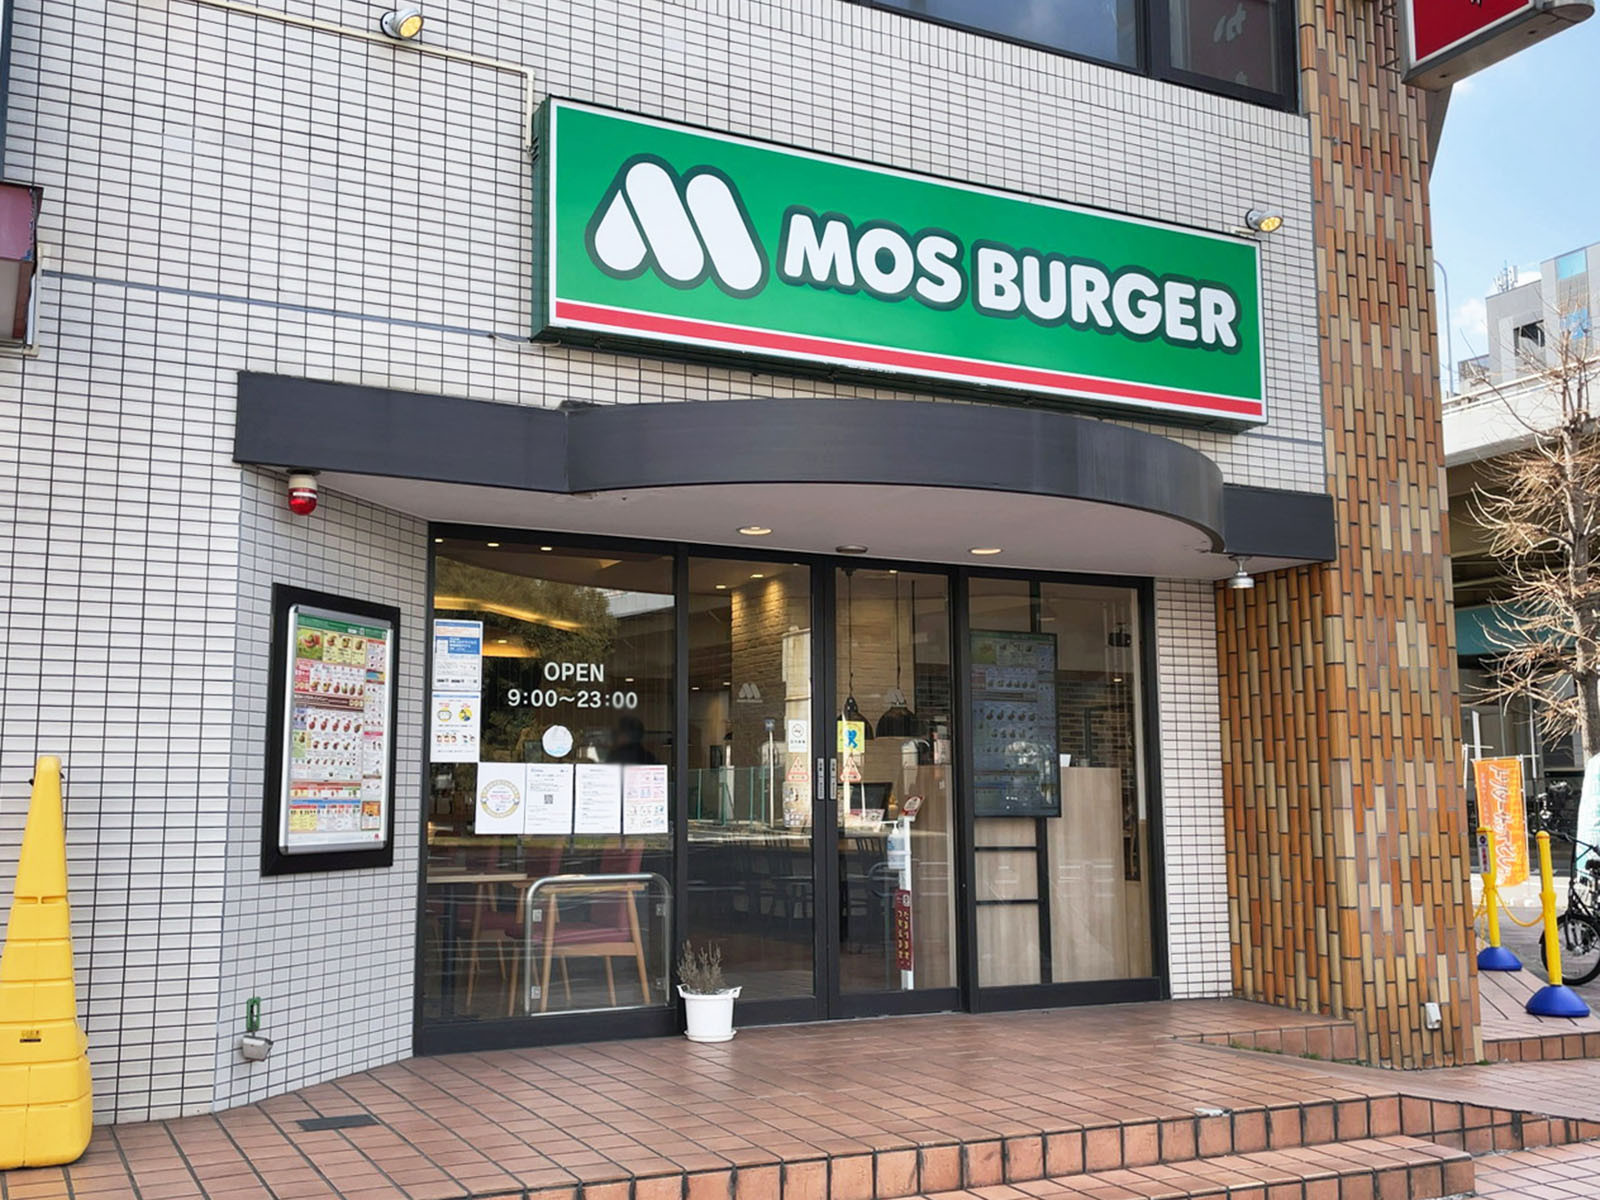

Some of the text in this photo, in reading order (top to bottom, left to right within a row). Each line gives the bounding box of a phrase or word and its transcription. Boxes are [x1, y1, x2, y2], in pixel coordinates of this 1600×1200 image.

[783, 212, 1238, 348] MOS BURGER
[543, 661, 605, 682] OPEN
